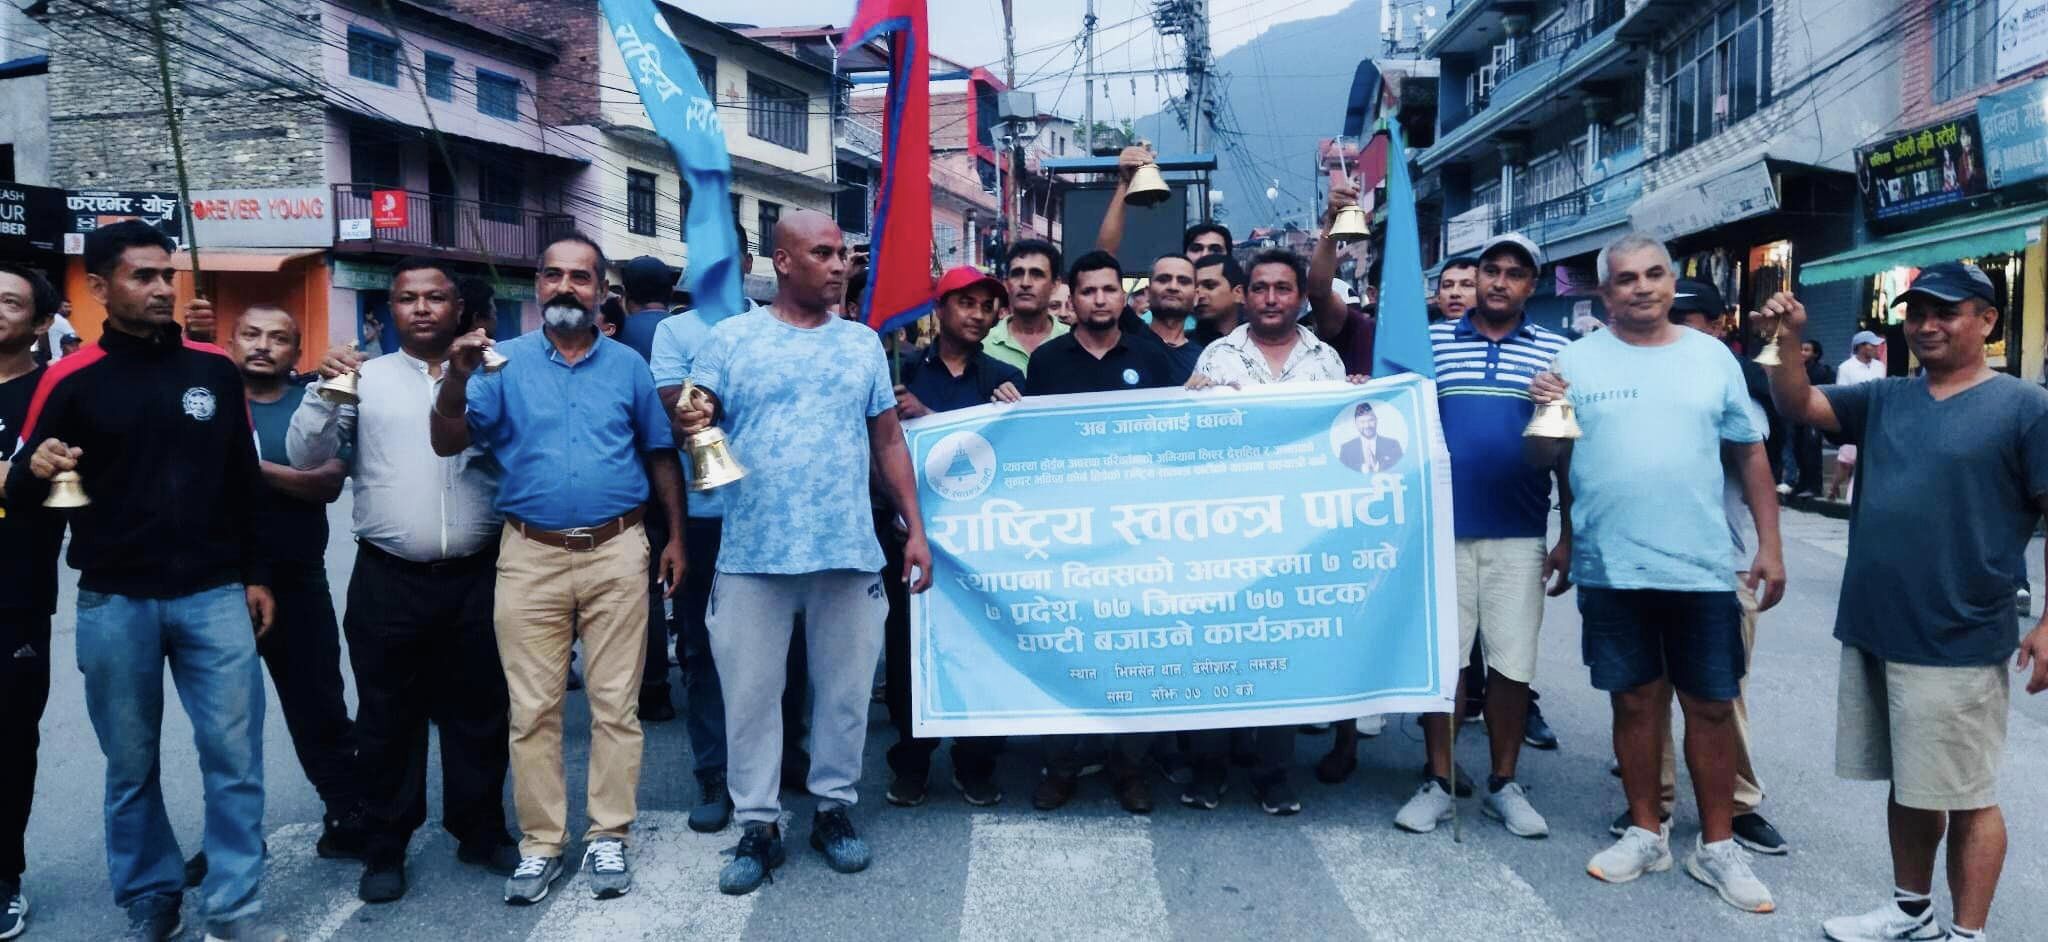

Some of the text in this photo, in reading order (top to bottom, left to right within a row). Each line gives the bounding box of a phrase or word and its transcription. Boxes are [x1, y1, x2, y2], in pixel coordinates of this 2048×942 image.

[268, 198, 324, 219] YOUNG
[0, 222, 27, 236] BER
[932, 473, 1407, 560] राष्ट्रिय स्वतन्त्र पार्टी
[955, 542, 1398, 593] स्थापना दिवसको अवसरमा ७ गते
[985, 603, 1001, 621] ७
[1093, 598, 1131, 618] ७७
[1142, 589, 1236, 616] जिल्ला
[1246, 589, 1284, 610] ७७
[1296, 582, 1368, 606] पटक
[1017, 616, 1344, 653] घण्टी बजाउने कार्यक्रम।
[1069, 668, 1097, 680] स्थान
[1106, 690, 1133, 703] समय
[1236, 681, 1254, 696] बजे
